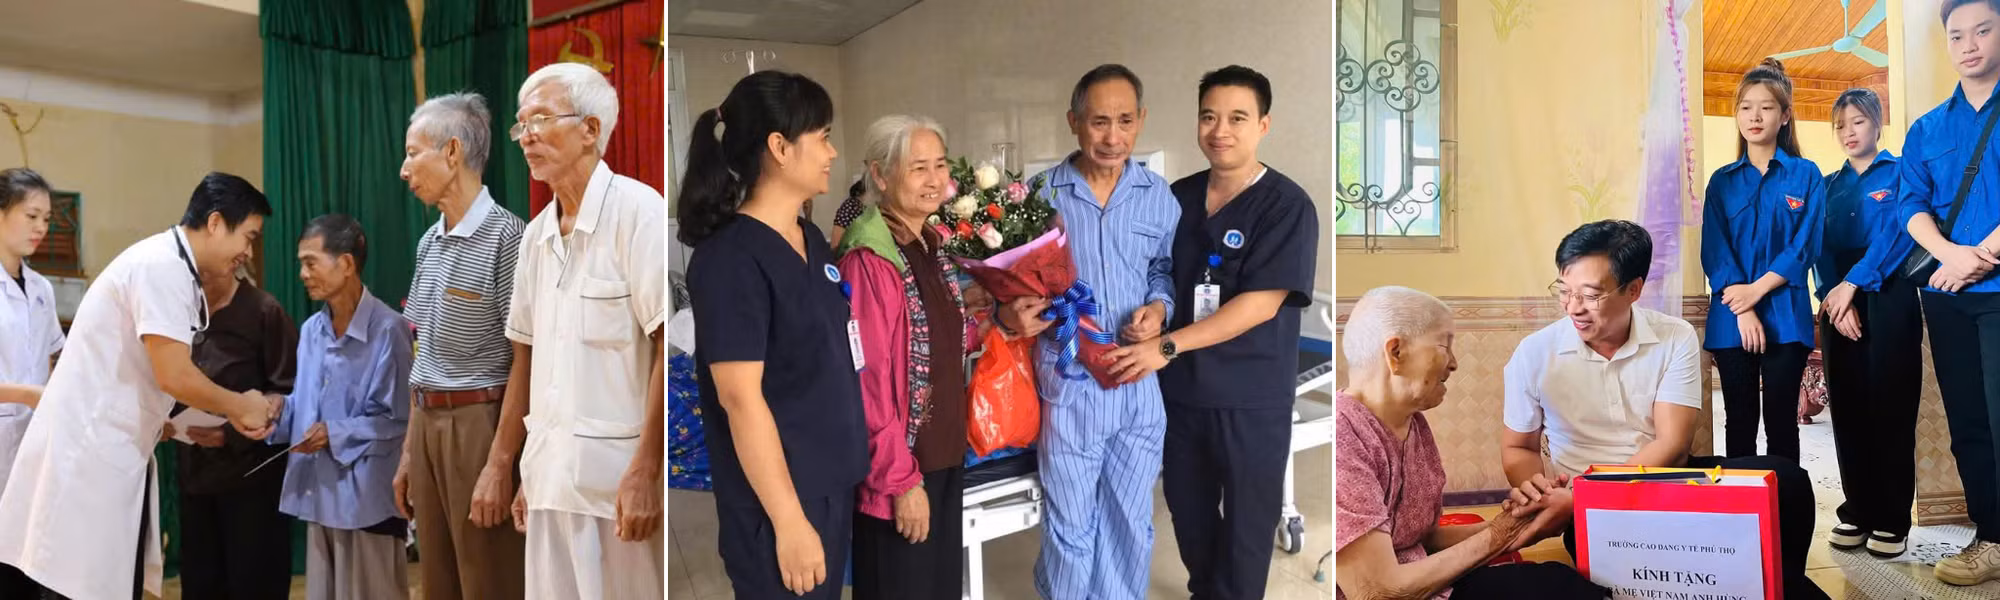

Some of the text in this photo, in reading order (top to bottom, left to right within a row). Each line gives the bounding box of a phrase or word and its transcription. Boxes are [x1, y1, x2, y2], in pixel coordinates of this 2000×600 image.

[1640, 542, 1657, 550] CAO
[1718, 546, 1736, 556] THỌ
[1632, 565, 1717, 587] KÍNH TẶNG
[1622, 587, 1638, 599] MẸ
[1639, 589, 1663, 600] VIỆT
[1665, 591, 1688, 600] NAM
